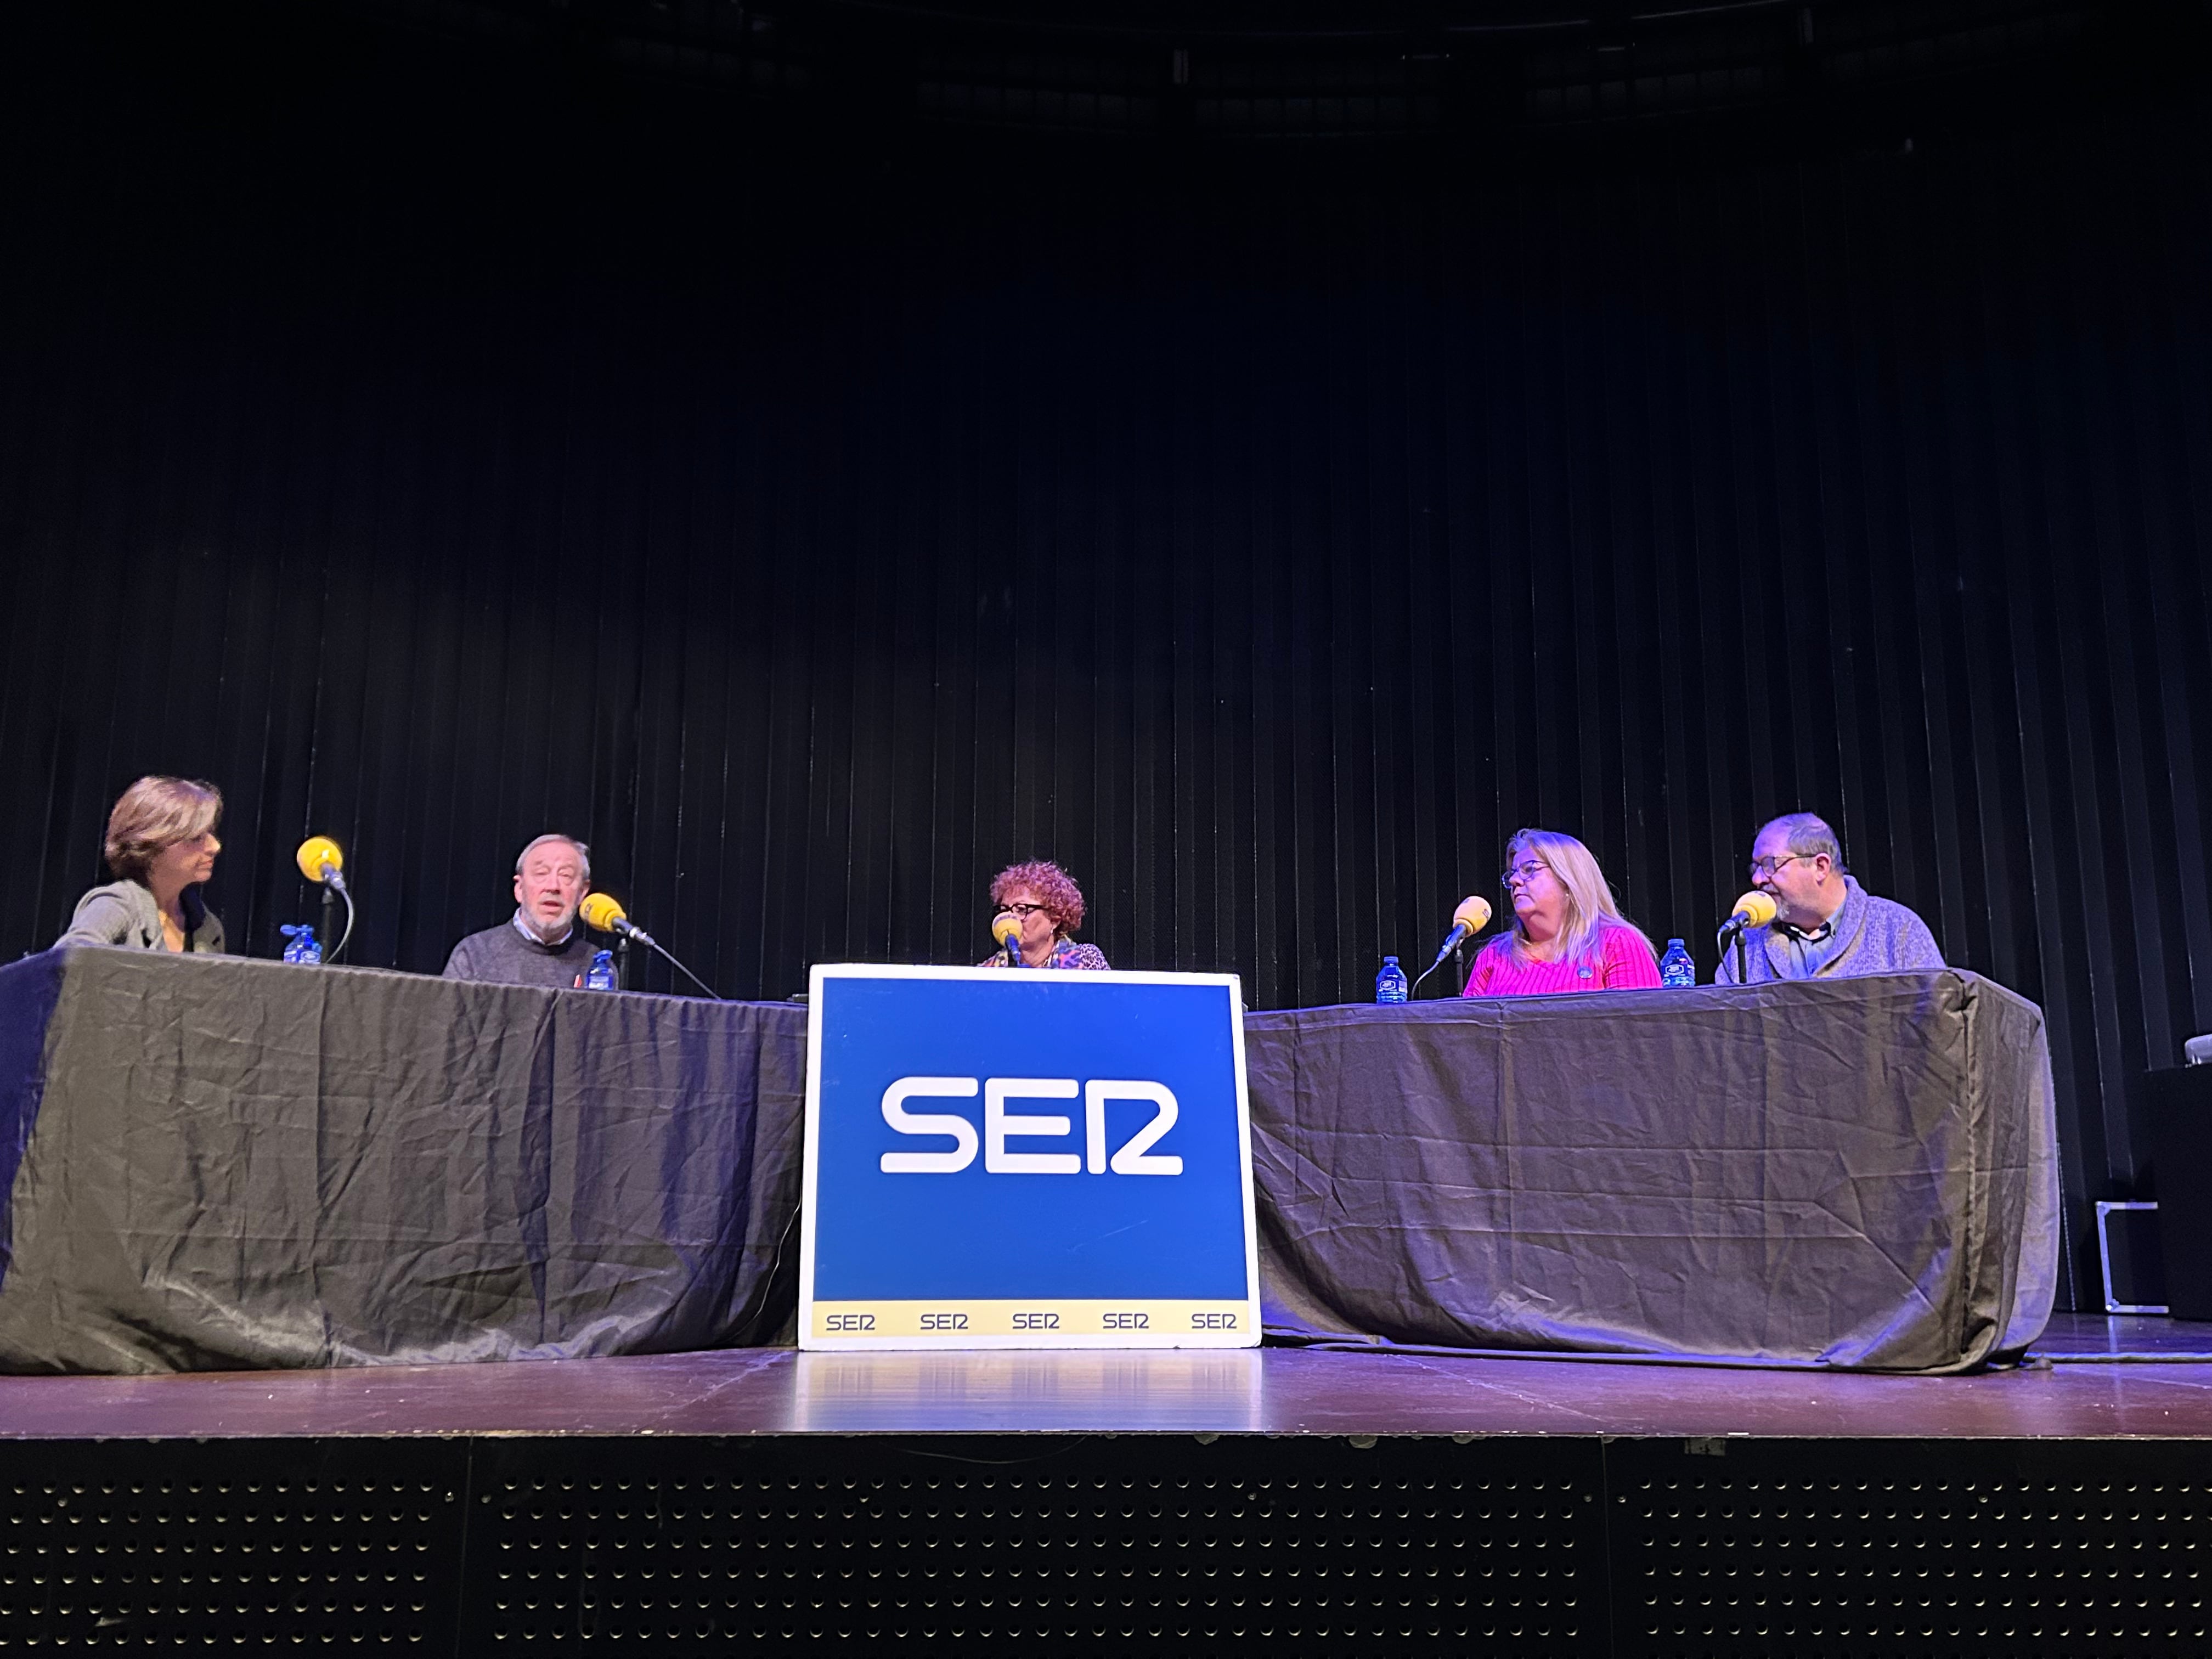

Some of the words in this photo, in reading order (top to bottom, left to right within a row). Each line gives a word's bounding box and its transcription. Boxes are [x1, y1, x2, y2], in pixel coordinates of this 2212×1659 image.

[880, 1076, 1183, 1176] SER
[826, 1314, 875, 1331] SER
[920, 1314, 968, 1330] SER
[1012, 1313, 1059, 1329] SER
[1103, 1313, 1149, 1329] SER
[1192, 1313, 1237, 1329] SER
